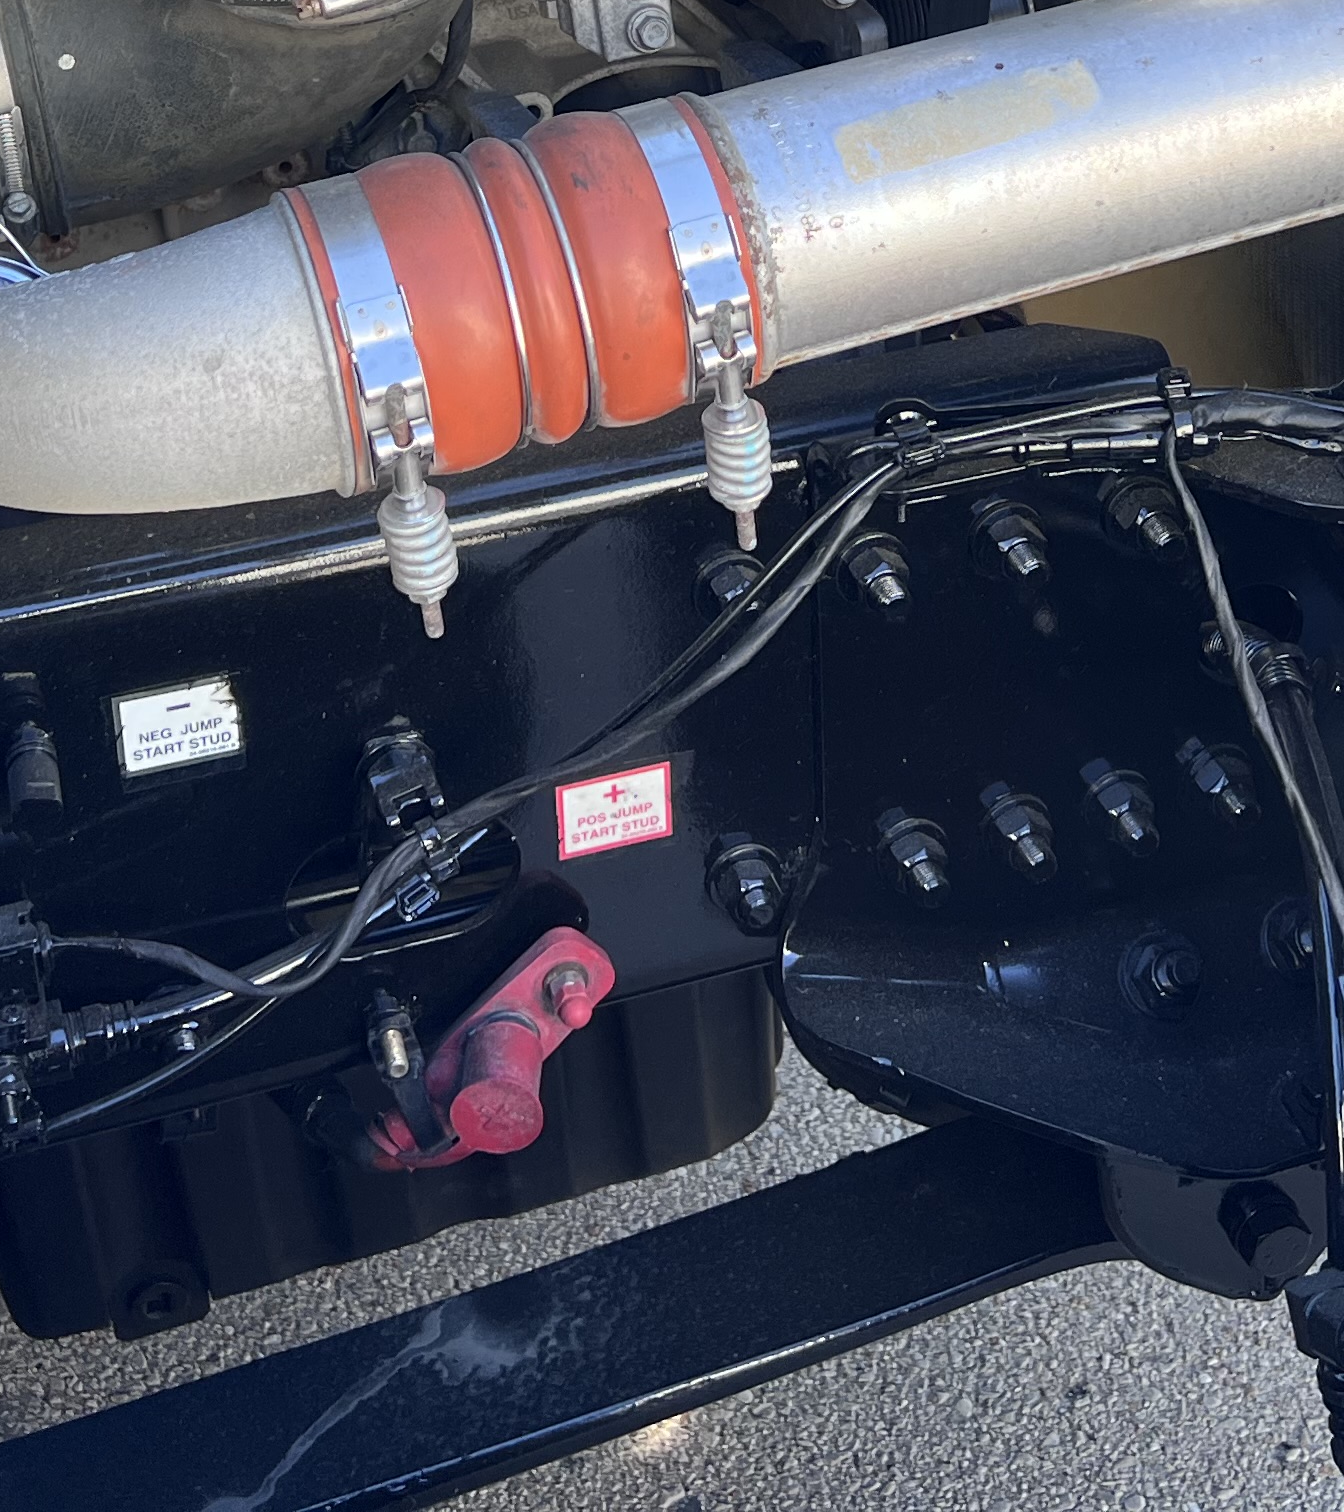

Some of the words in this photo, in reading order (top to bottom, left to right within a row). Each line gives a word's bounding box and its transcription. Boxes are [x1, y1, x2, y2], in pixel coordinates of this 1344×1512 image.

[139, 727, 172, 744] NEG
[180, 717, 223, 735] JUMP
[133, 740, 185, 761] START
[189, 731, 232, 750] STUD
[577, 812, 607, 828] POS
[614, 802, 653, 820] JUMP
[571, 824, 618, 844] START
[622, 815, 660, 832] STUD
